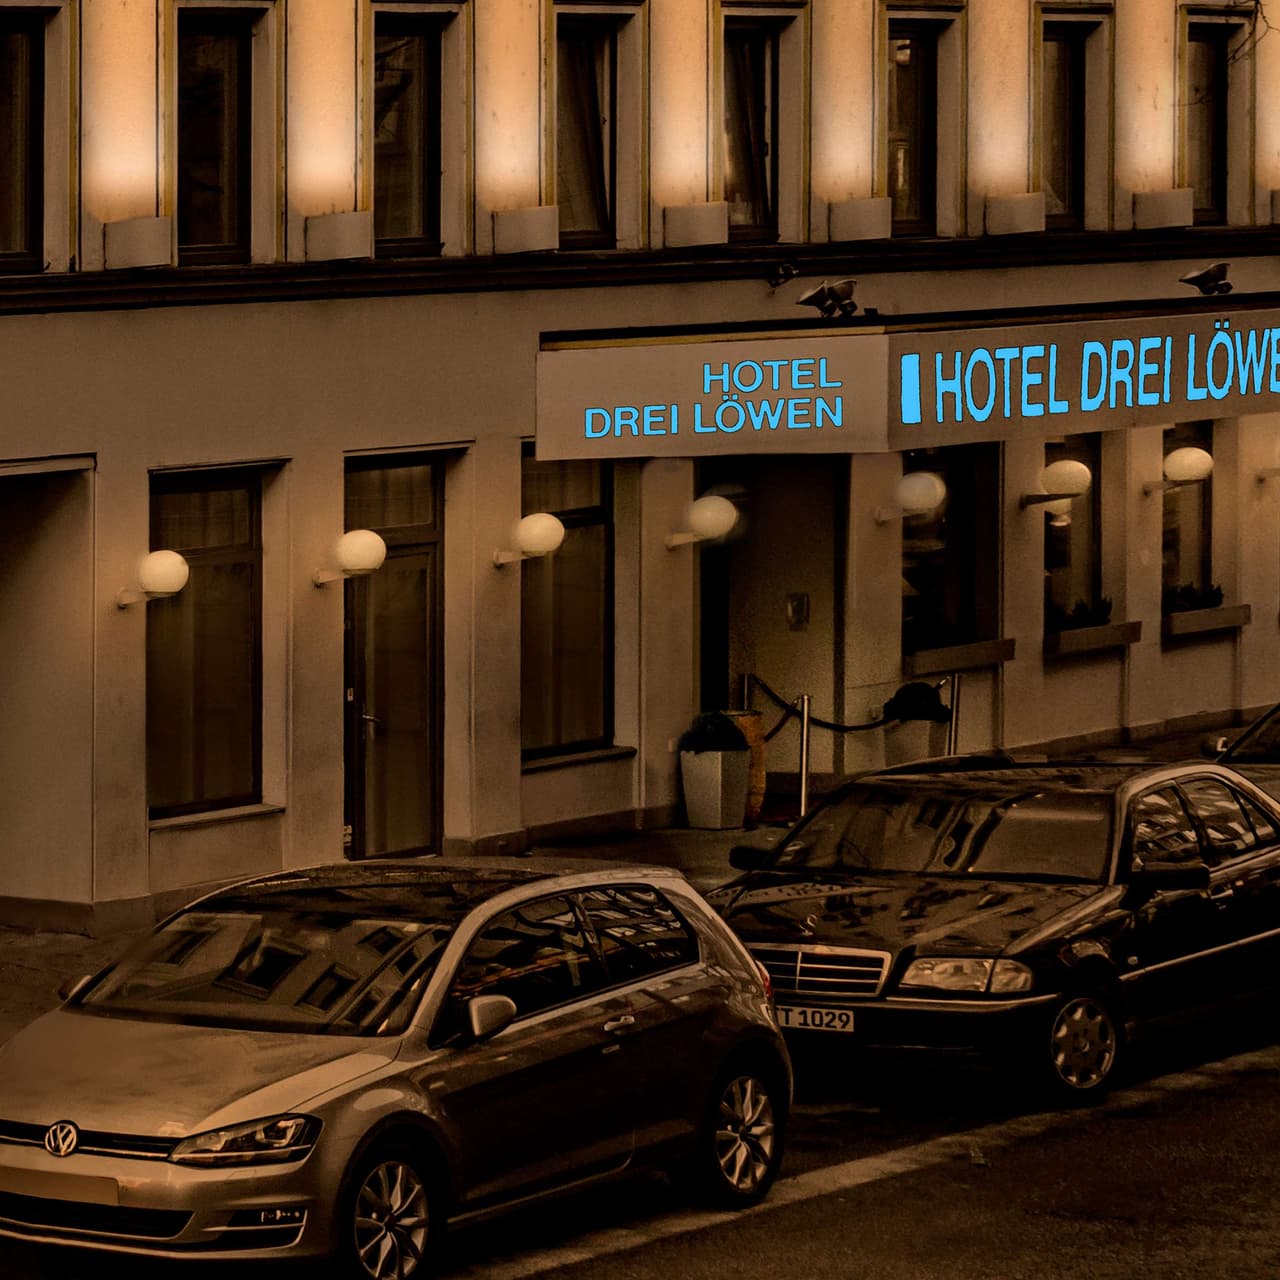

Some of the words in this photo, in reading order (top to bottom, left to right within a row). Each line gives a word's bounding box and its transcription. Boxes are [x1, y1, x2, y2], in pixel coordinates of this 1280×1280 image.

[702, 357, 843, 394] HOTEL
[934, 339, 1070, 425] HOTEL
[1079, 335, 1173, 413] DREI
[584, 398, 679, 439] DREI
[693, 391, 844, 436] LÖWEN
[797, 1009, 851, 1029] 1029
